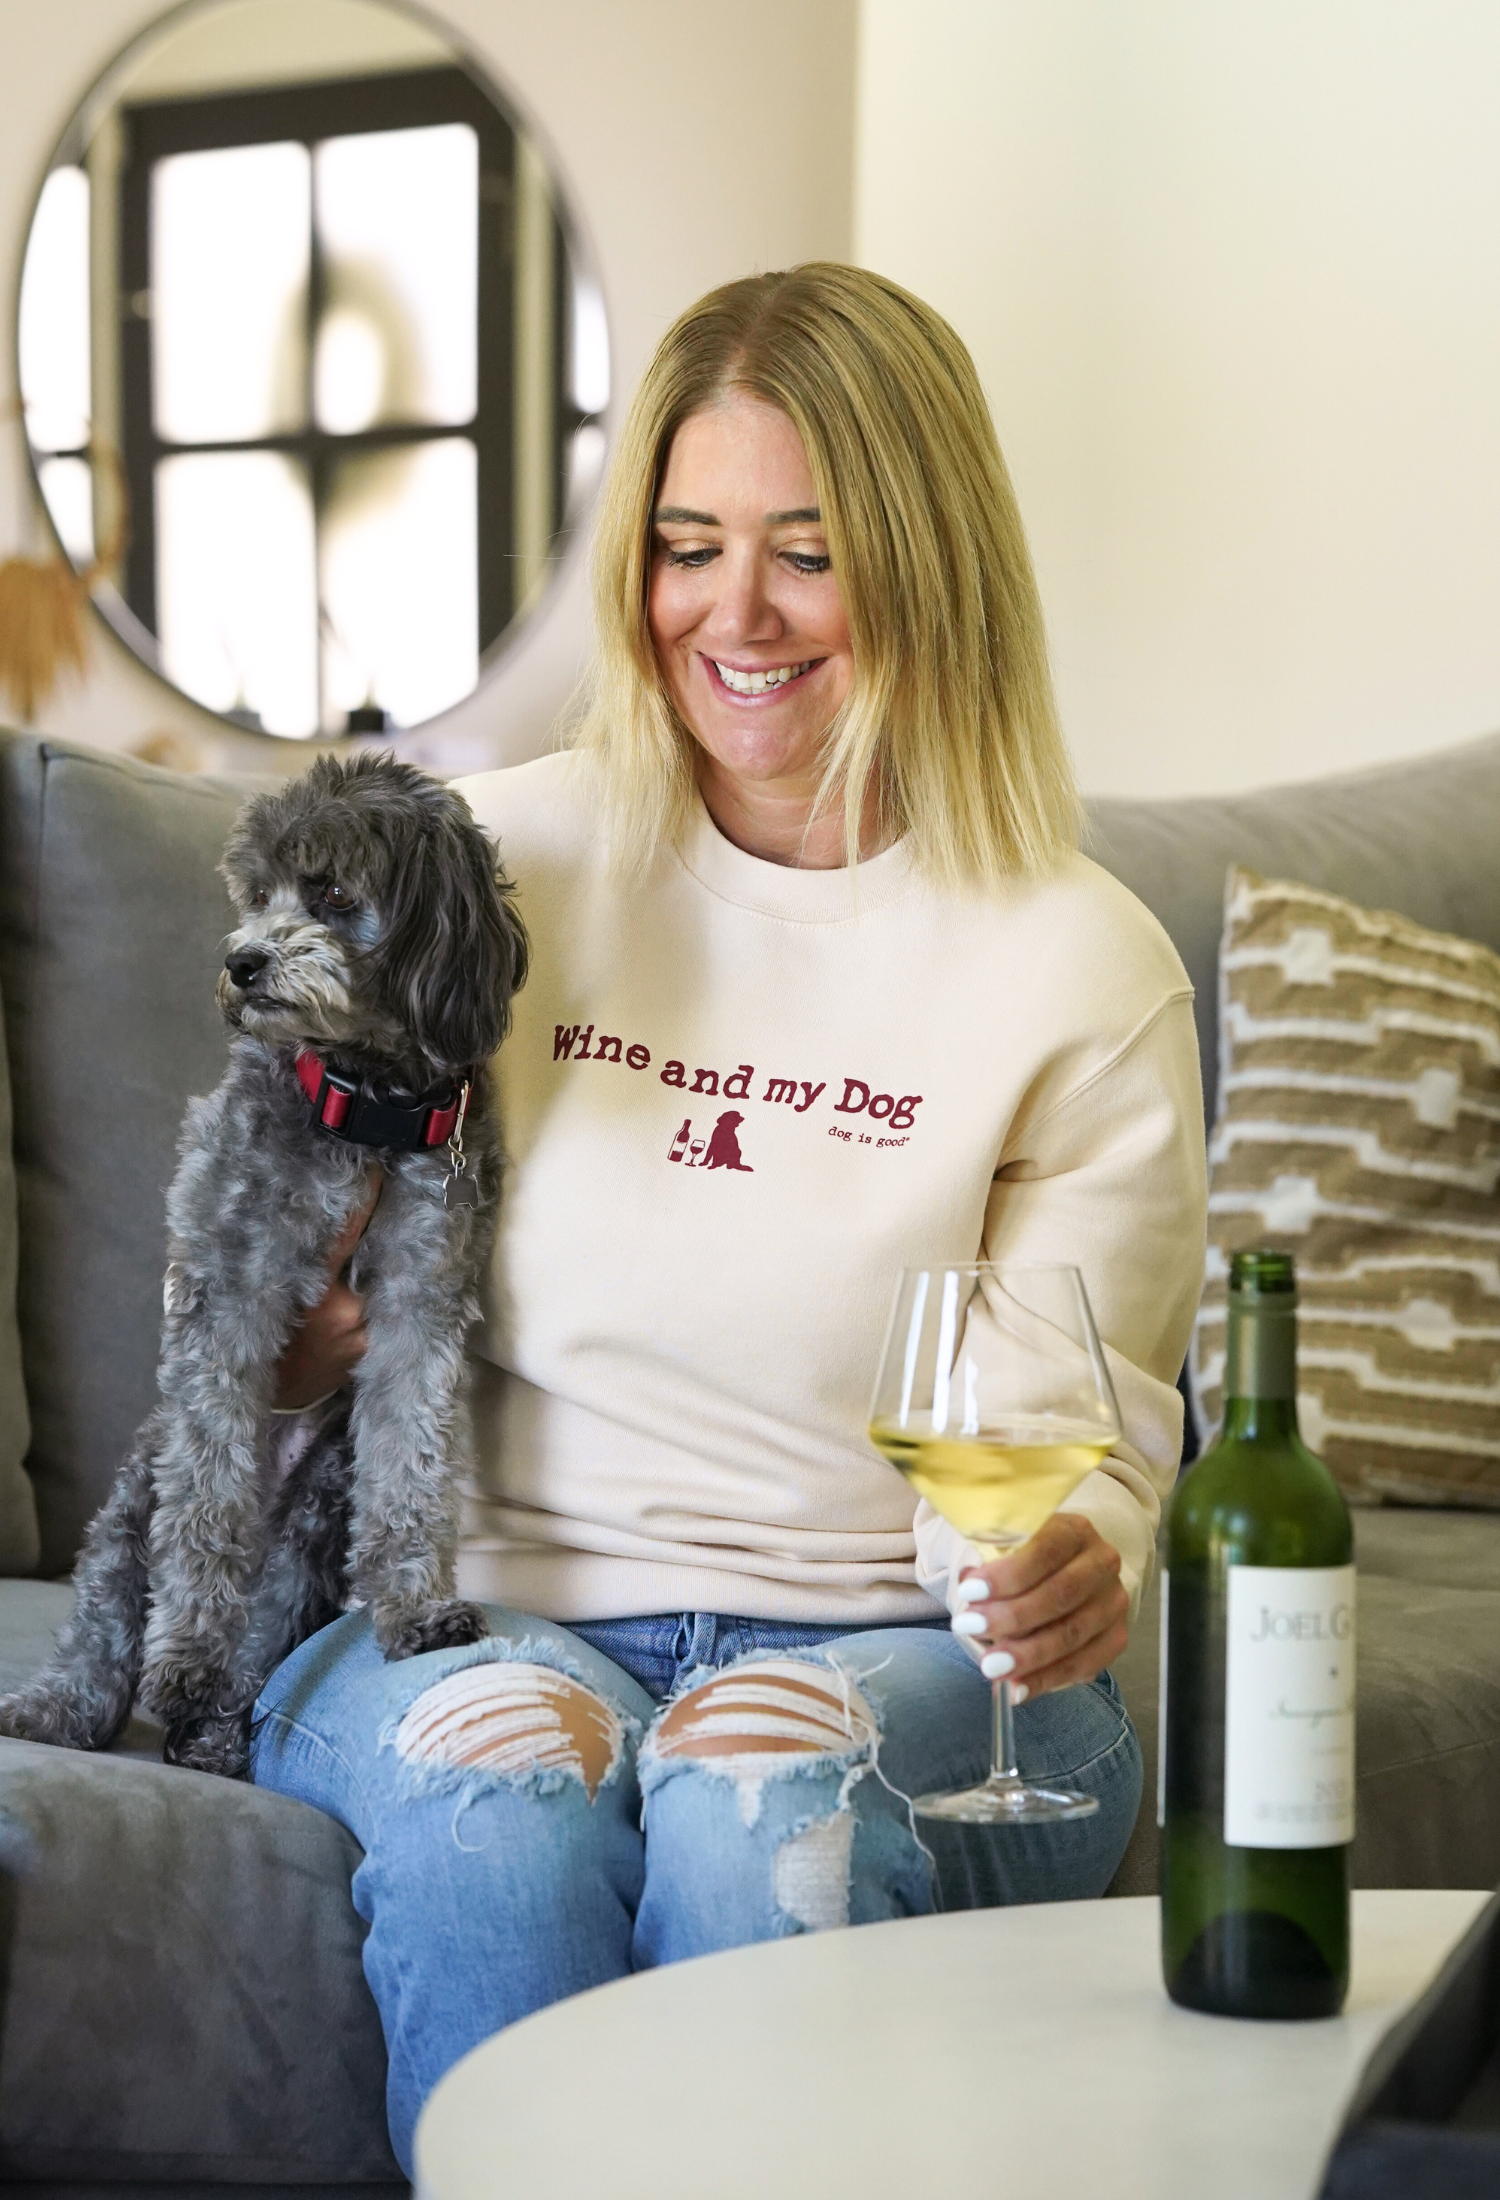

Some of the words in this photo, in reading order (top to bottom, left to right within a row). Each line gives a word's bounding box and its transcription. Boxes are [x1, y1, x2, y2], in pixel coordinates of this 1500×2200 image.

[552, 1025, 651, 1070] Wine
[660, 1060, 755, 1099] and
[763, 1078, 827, 1112] my
[834, 1078, 923, 1130] Dog
[828, 1126, 853, 1142] dog
[858, 1133, 872, 1144] is
